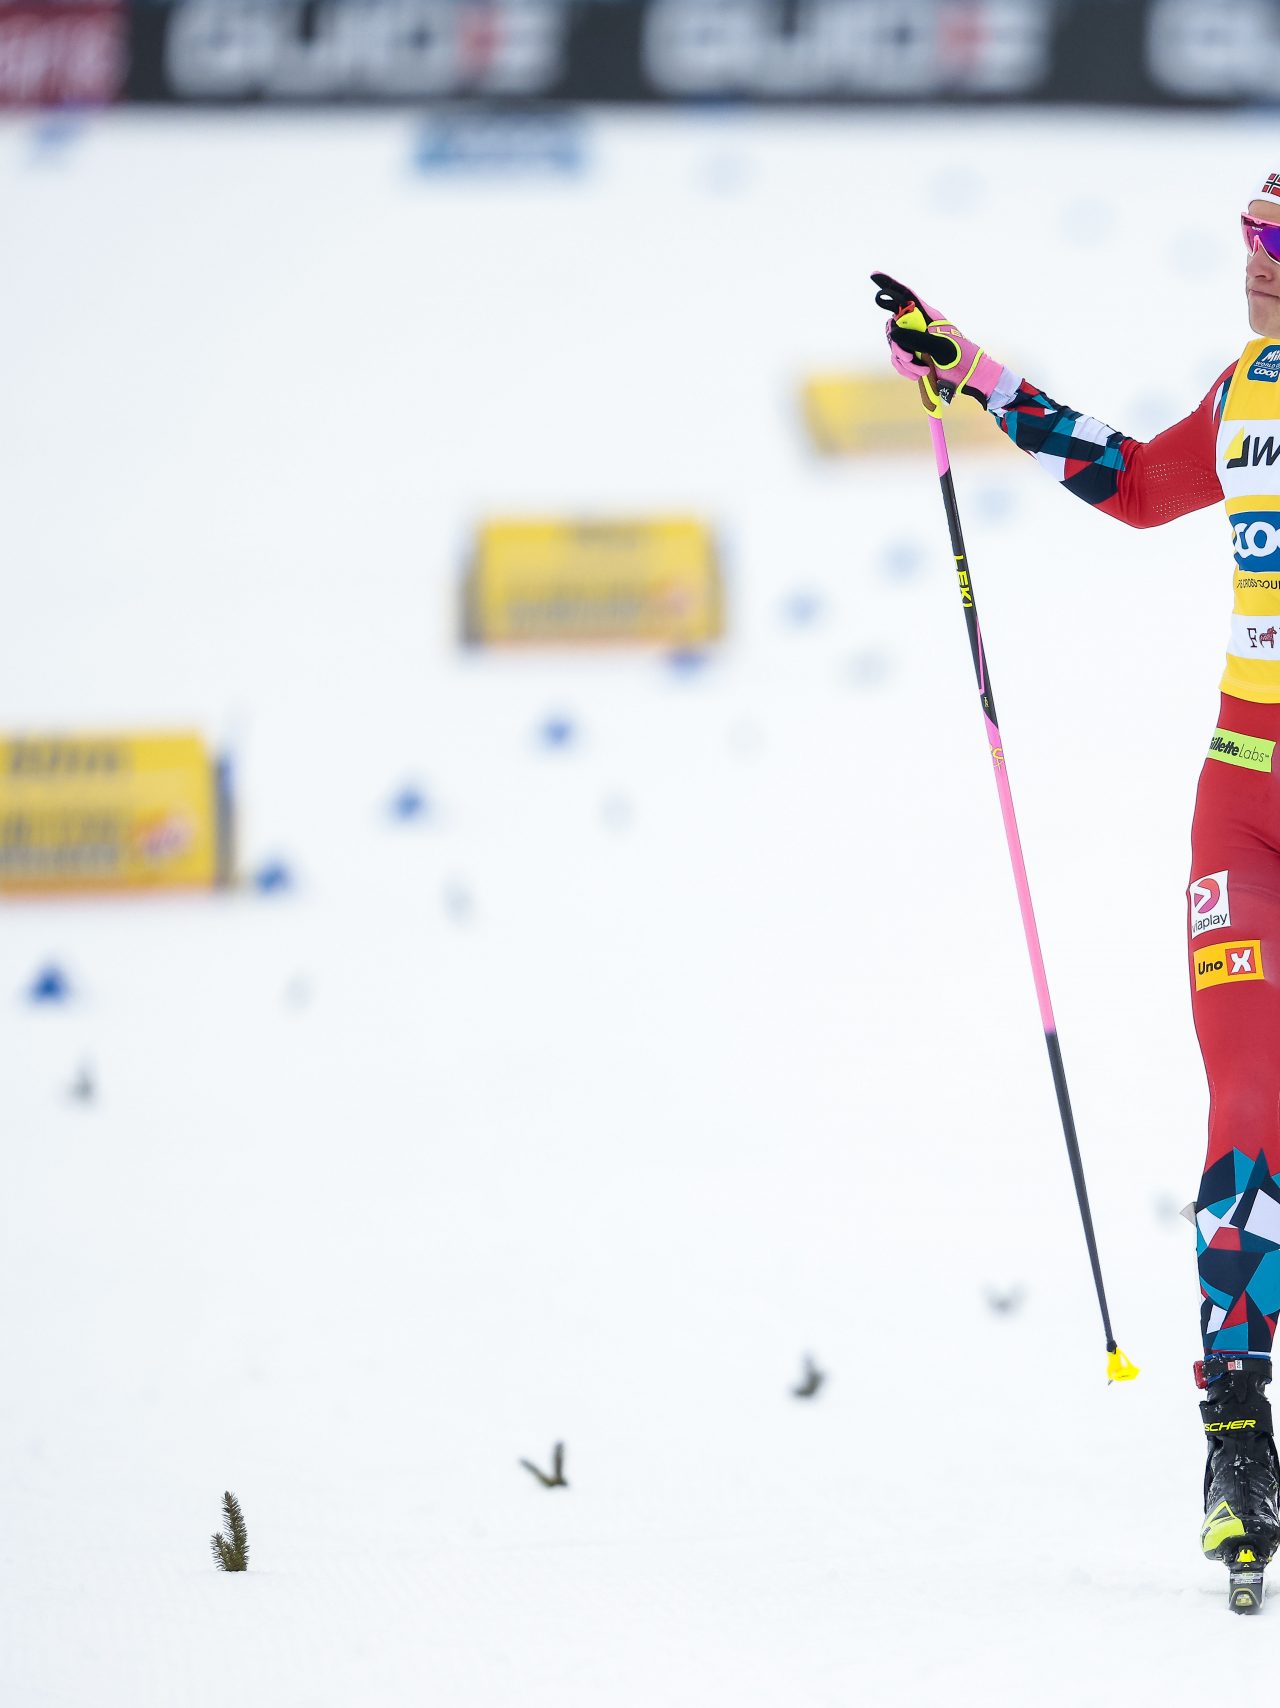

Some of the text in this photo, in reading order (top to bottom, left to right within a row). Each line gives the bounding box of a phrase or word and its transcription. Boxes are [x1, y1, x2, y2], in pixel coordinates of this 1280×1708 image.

[1253, 367, 1279, 378] coop
[954, 555, 973, 608] LEKI
[1198, 948, 1252, 975] Uno X
[1204, 1419, 1257, 1432] SCHER
